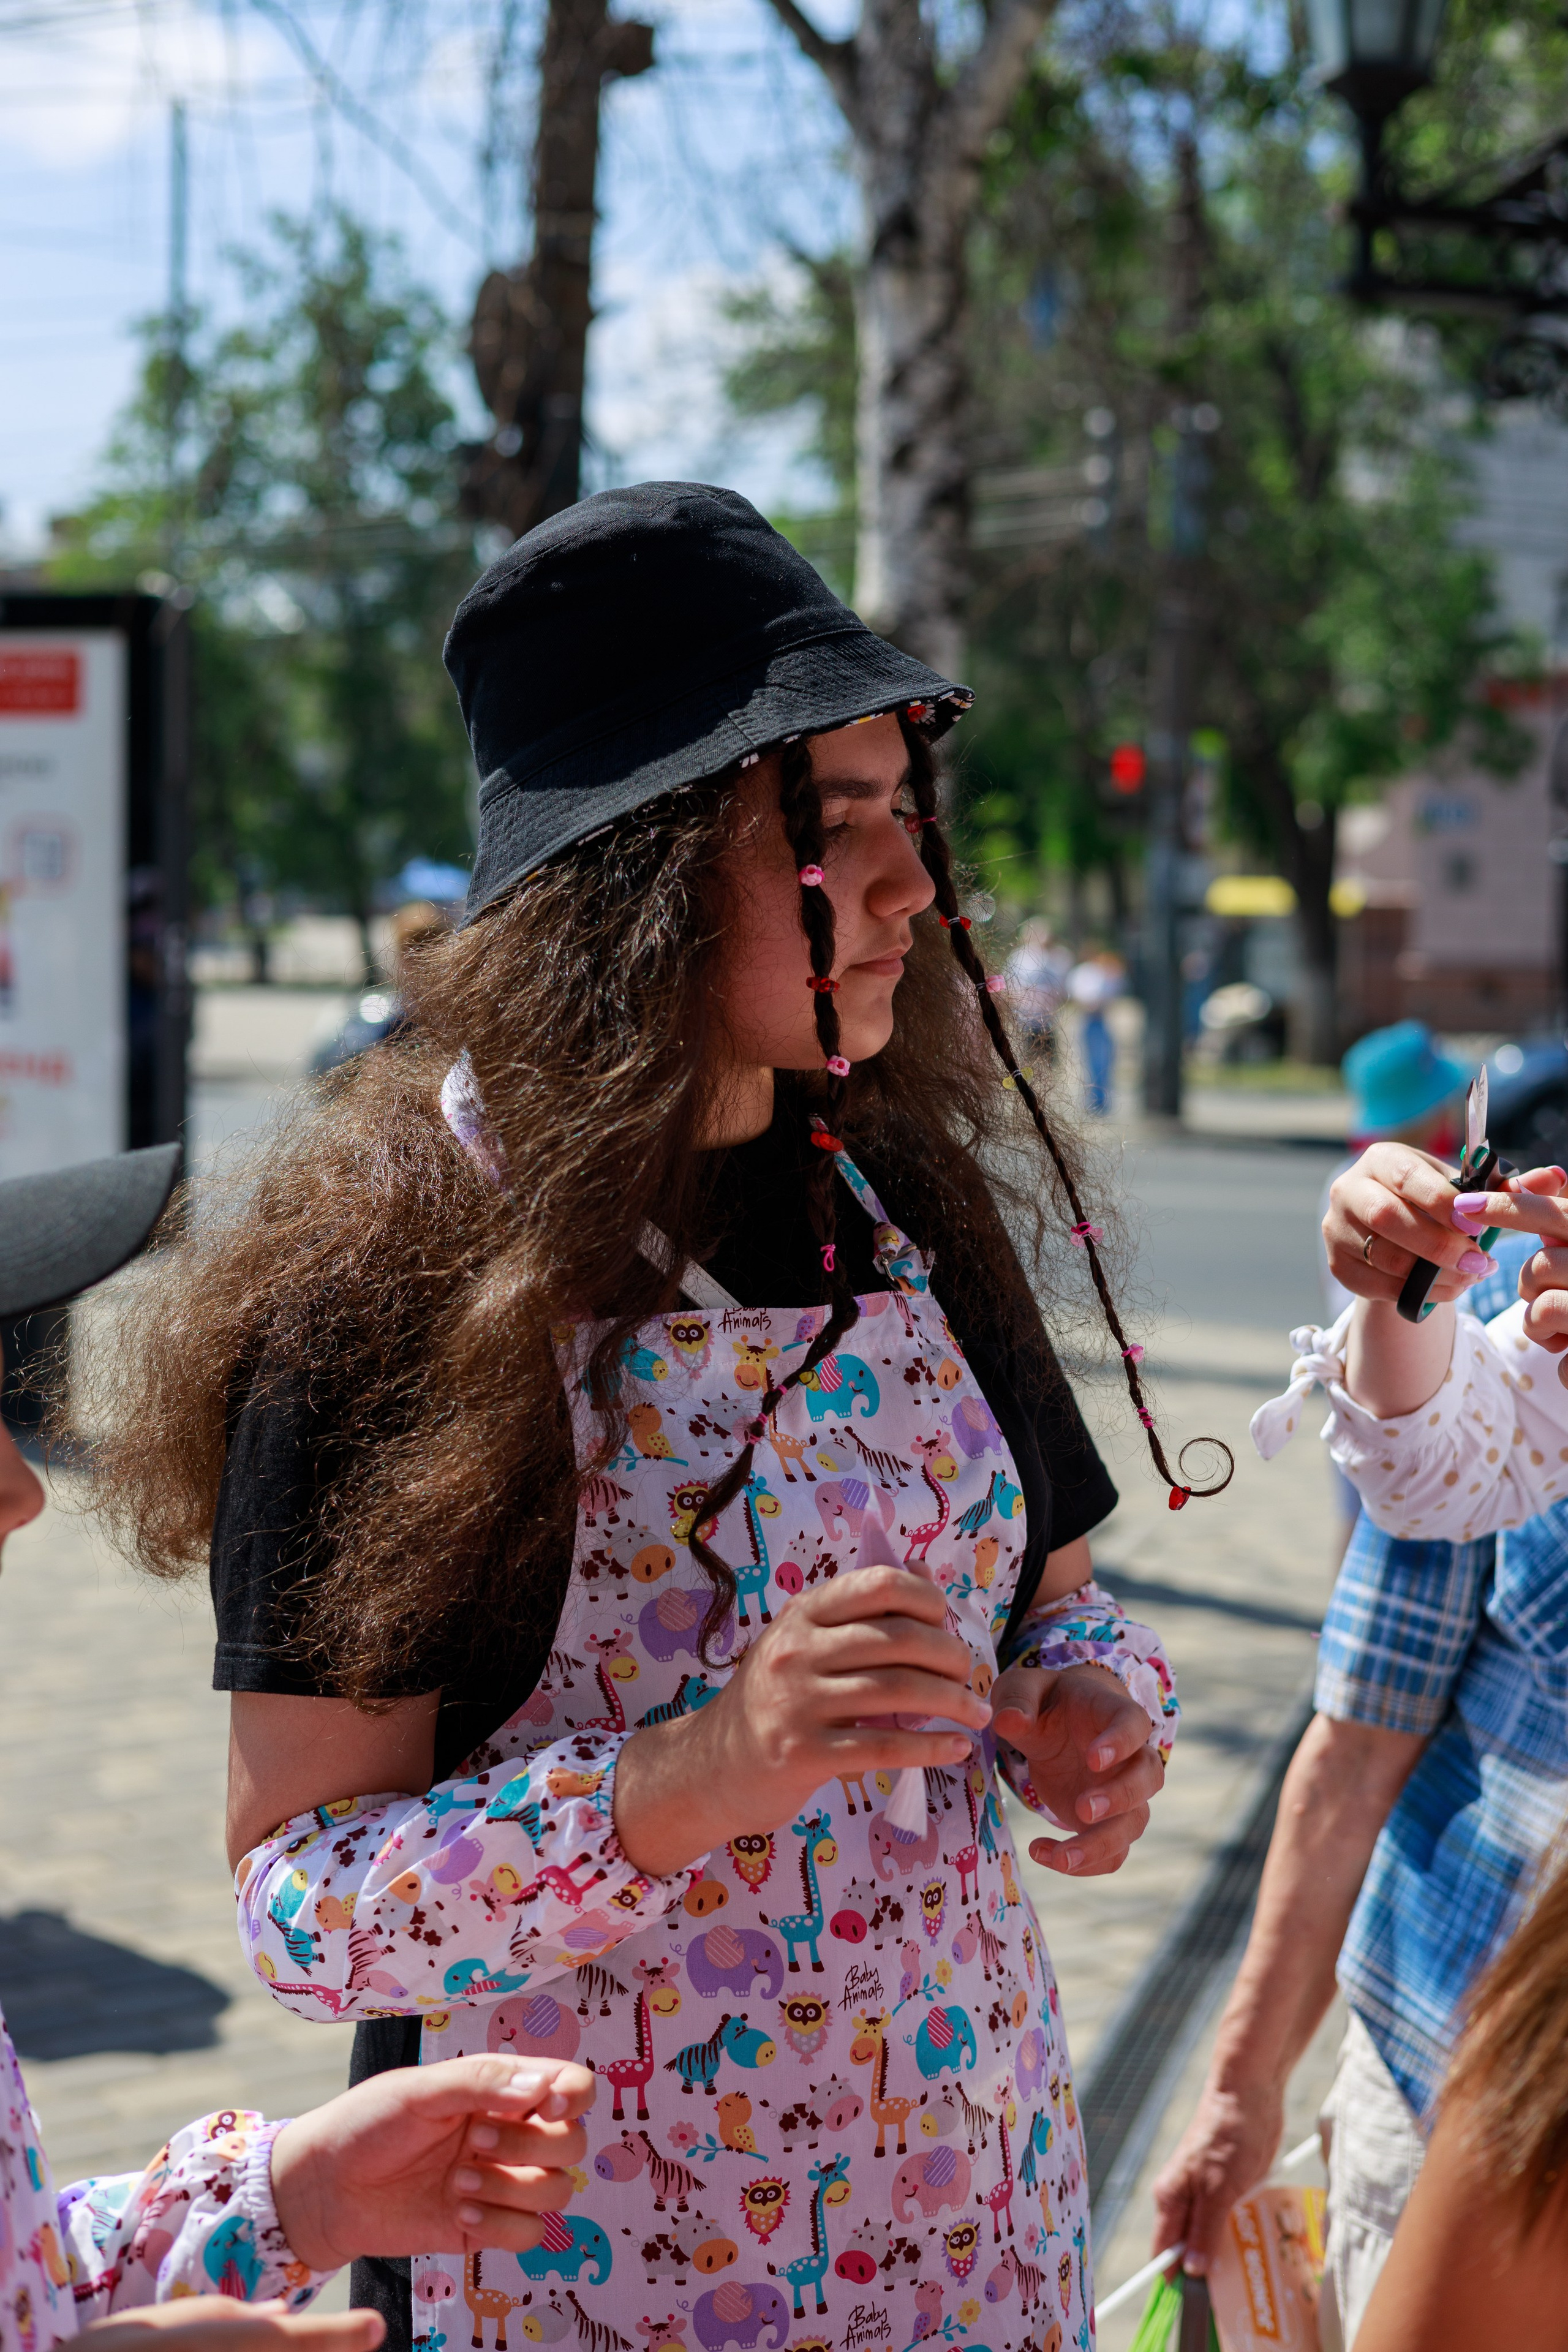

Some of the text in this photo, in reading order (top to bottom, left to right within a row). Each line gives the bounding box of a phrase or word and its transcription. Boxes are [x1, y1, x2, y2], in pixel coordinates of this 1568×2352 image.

[717, 1308, 772, 1334] Animals
[845, 1961, 880, 1989] Baby
[837, 1979, 884, 2011] Animals
[848, 2301, 888, 2330] Baby
[840, 2320, 892, 2351] Animals
